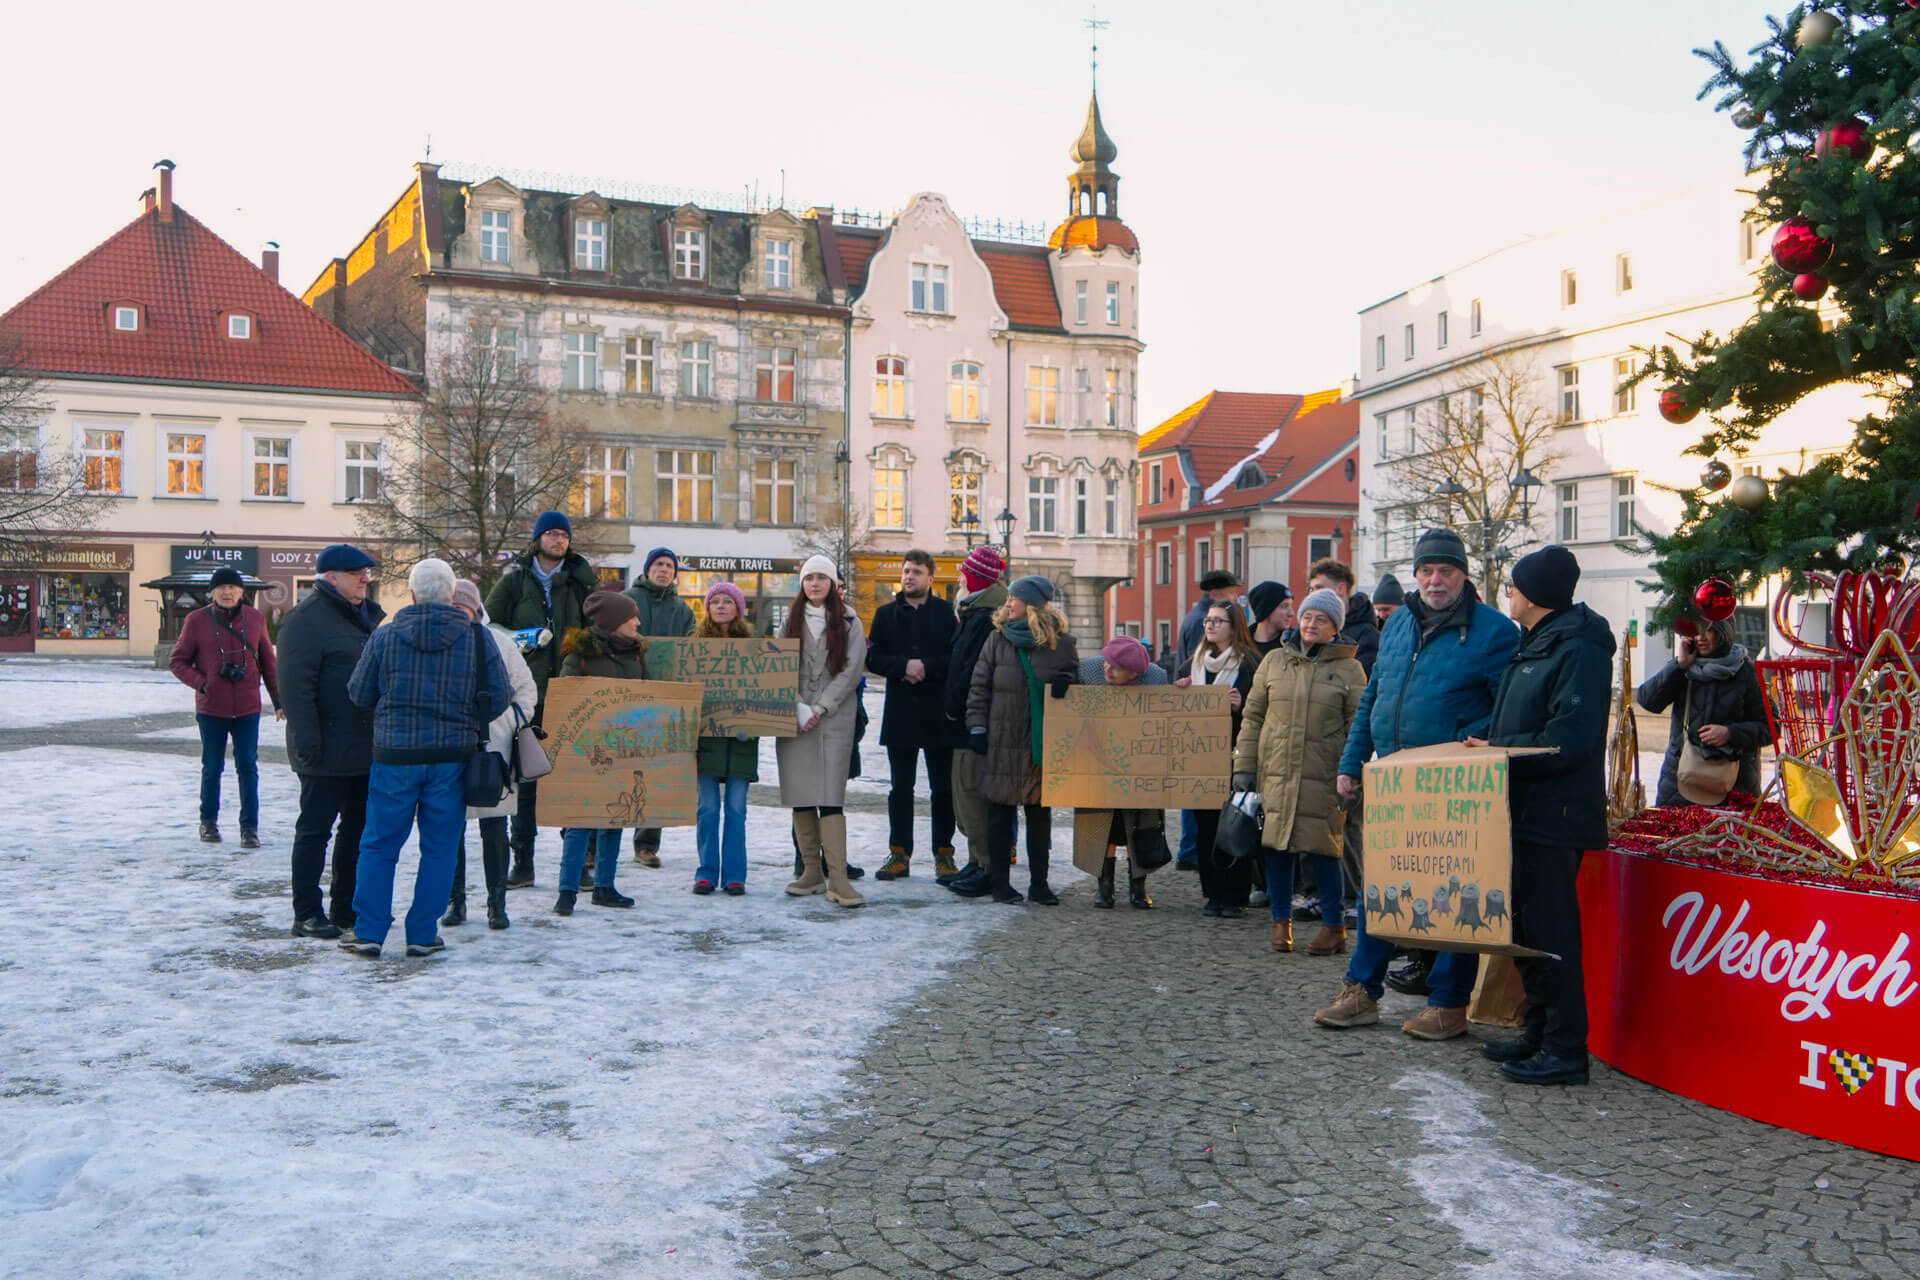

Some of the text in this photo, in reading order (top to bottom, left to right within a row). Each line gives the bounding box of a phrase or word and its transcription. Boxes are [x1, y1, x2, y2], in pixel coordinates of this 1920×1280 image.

[271, 552, 301, 563] LODY
[304, 553, 311, 563] Z
[699, 558, 774, 571] RZEMYK TRAVEL
[677, 640, 711, 658] TAK
[677, 655, 800, 676] REZERWATU
[1171, 757, 1187, 772] W
[1133, 777, 1228, 795] REPTACH
[1370, 761, 1508, 798] TAK REZERWAT
[1405, 829, 1469, 850] WYCINKAMI
[1390, 854, 1476, 877] DEWELOPERAMI
[1799, 1040, 1828, 1091] I
